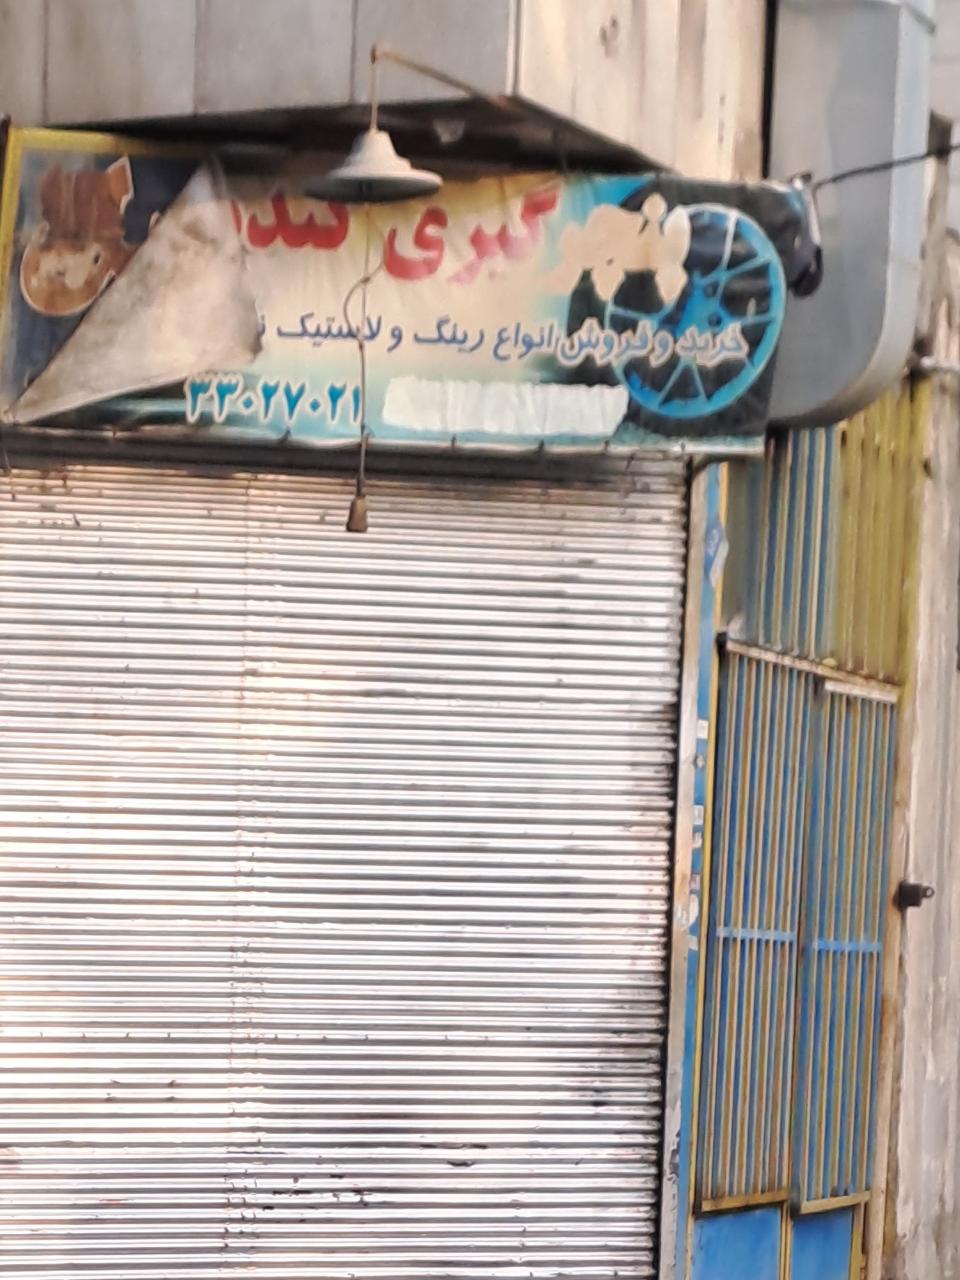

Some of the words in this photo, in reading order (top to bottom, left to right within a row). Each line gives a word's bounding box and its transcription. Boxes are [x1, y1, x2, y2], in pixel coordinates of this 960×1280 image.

[276, 312, 384, 349] لاستیک
[385, 327, 405, 353] و
[412, 314, 485, 355] رینگ
[491, 318, 556, 363] انواع
[556, 317, 651, 366] فروش
[649, 329, 674, 367] و
[676, 320, 749, 366] خرید
[185, 373, 362, 424] ۳۳۰۲۷۰۲۱
